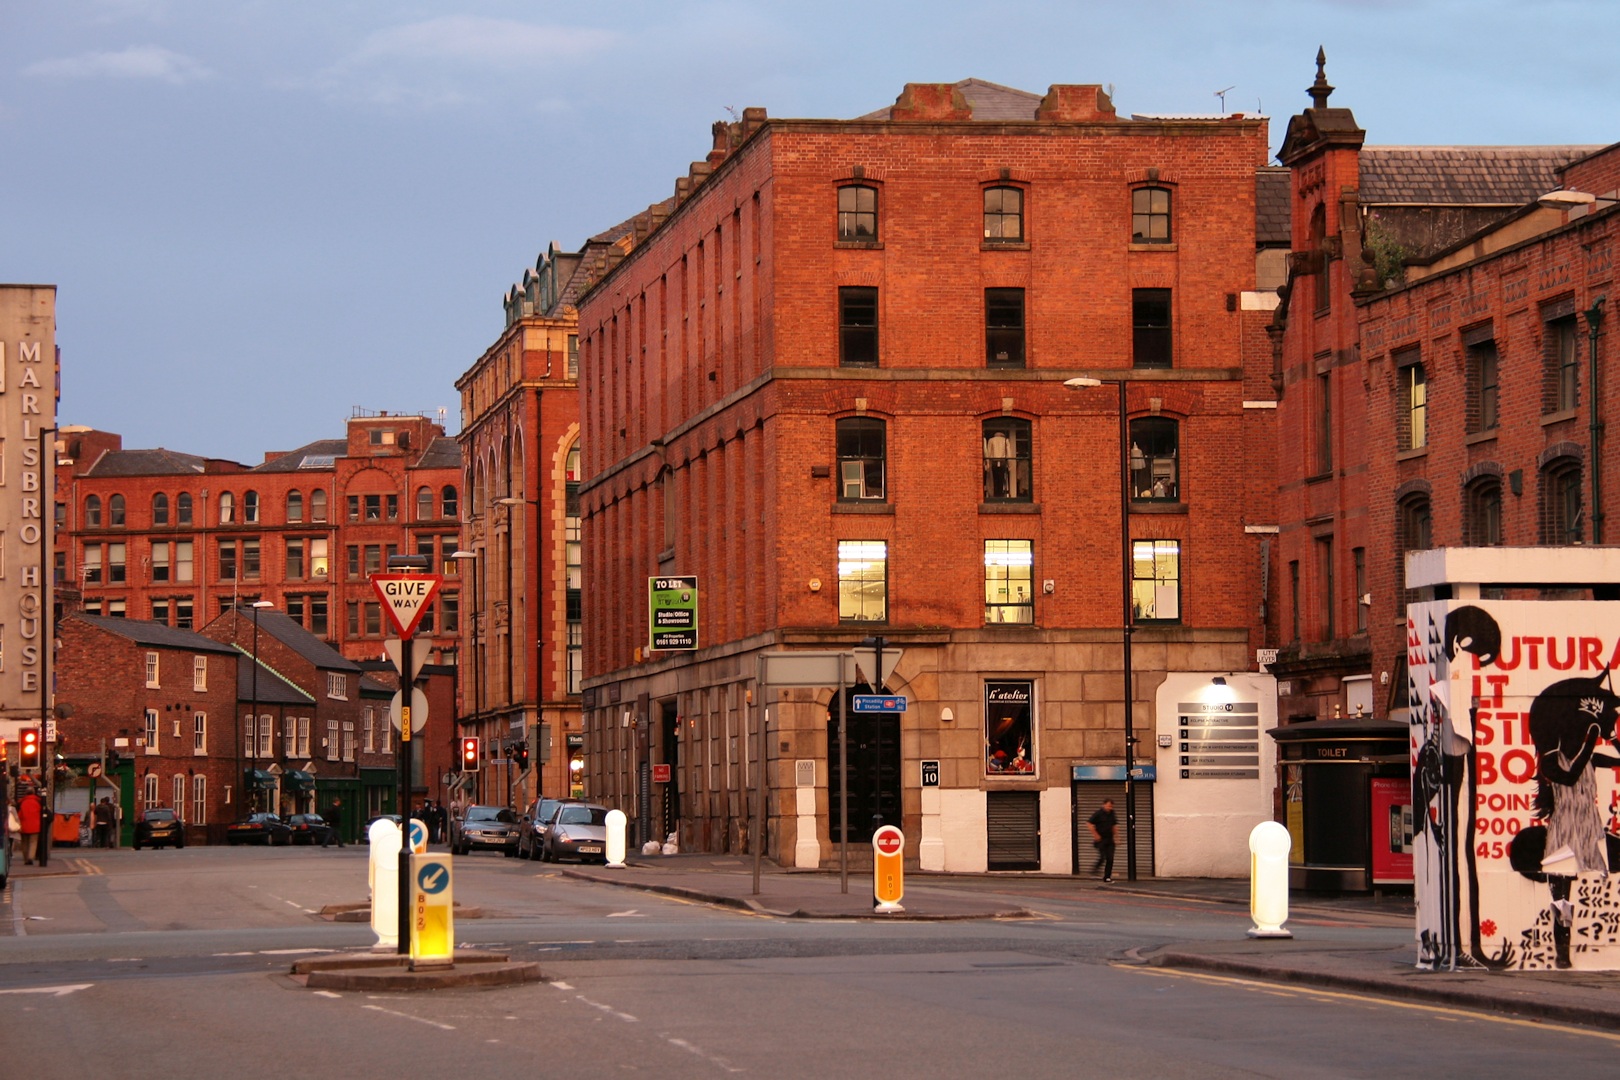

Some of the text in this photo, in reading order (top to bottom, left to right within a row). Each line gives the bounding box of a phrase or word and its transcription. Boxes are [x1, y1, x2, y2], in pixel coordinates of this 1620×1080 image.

[19, 341, 41, 692] MARLSBRO HOUSE
[385, 582, 426, 596] GIVE
[656, 579, 683, 589] TO LET
[393, 599, 419, 608] WAY
[1472, 636, 1620, 671] UTUR
[1472, 675, 1509, 709] LT
[1317, 748, 1348, 757] TOILET
[925, 773, 937, 783] 10
[1476, 817, 1521, 836] 900
[1476, 841, 1512, 860] 45
